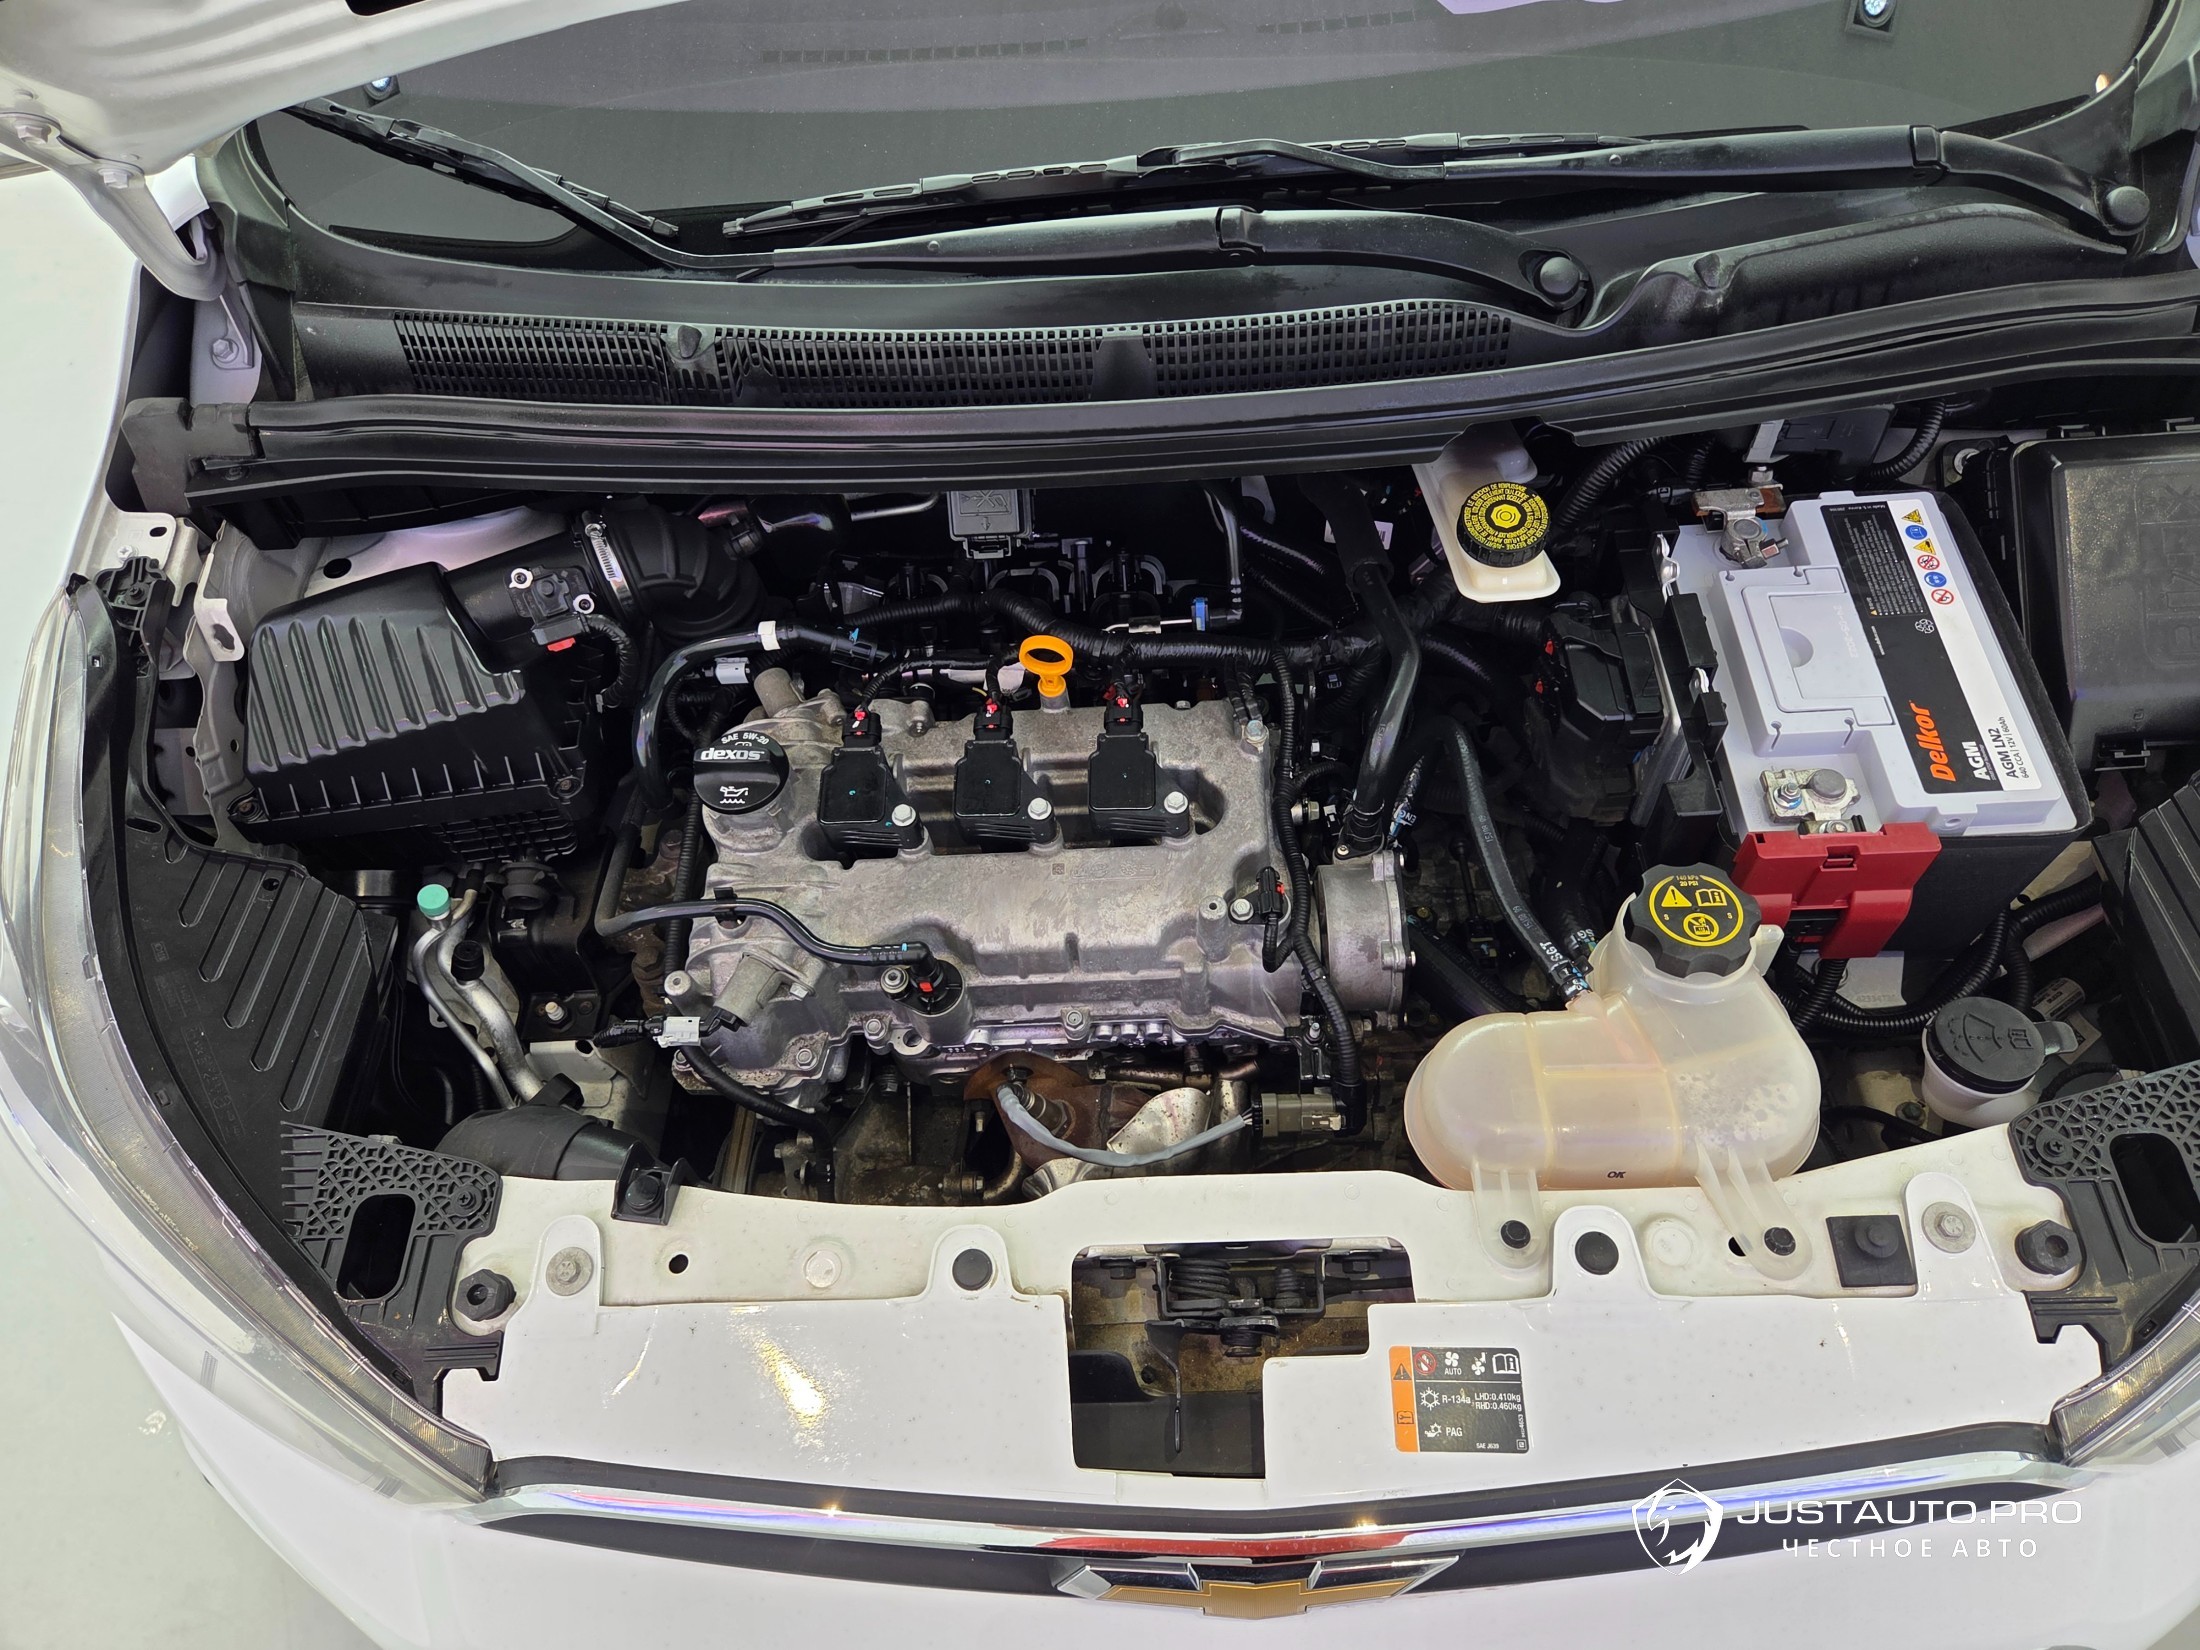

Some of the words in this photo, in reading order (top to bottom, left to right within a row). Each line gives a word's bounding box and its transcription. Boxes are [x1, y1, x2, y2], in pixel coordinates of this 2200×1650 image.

[721, 733, 739, 744] SAE
[742, 732, 770, 744] 5W-20
[1910, 702, 1956, 781] Delkor
[1988, 728, 2006, 749] LN2
[700, 748, 765, 760] dexos
[1962, 741, 1991, 780] AGM
[2014, 752, 2024, 766] CCA
[1998, 751, 2020, 778] AGM
[1540, 942, 1564, 962] SGT
[1607, 1170, 1626, 1180] OK
[1444, 1368, 1462, 1376] AUTO
[1442, 1394, 1471, 1404] R-134a
[1446, 1426, 1463, 1437] PAG
